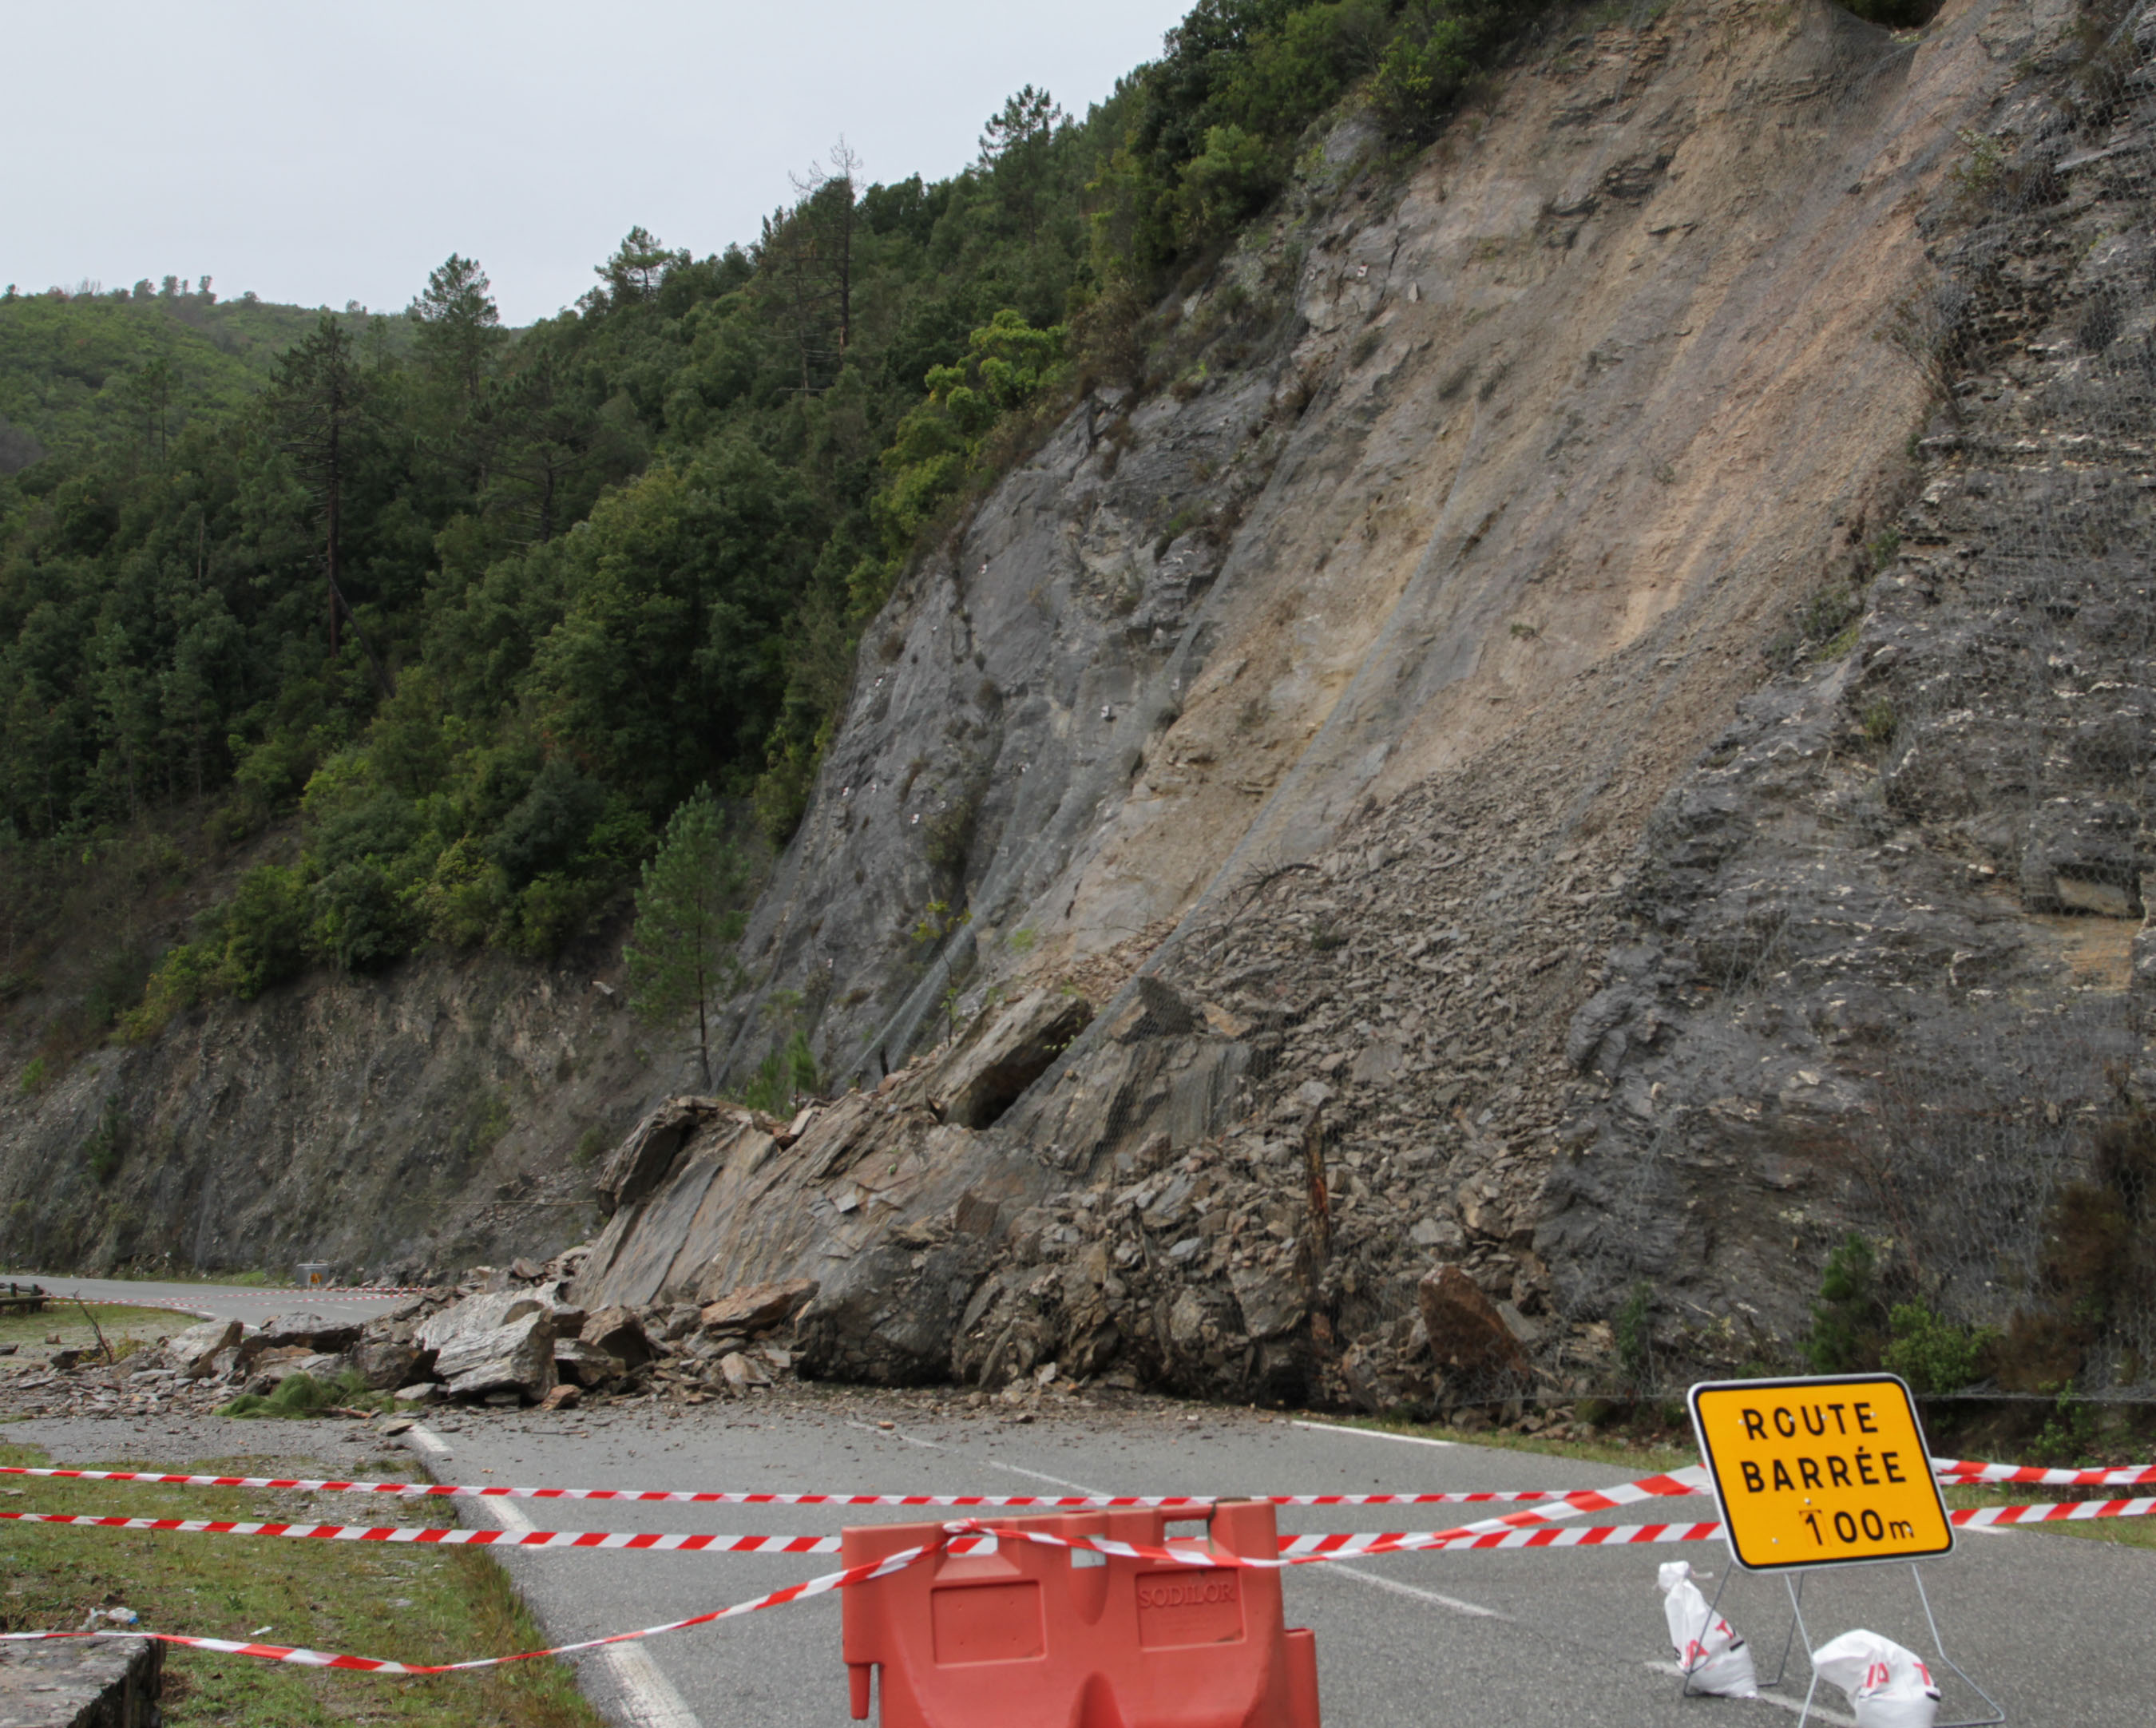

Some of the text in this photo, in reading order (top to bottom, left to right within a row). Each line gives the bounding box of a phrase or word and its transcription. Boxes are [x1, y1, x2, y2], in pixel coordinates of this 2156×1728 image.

[1742, 1402, 1878, 1440] ROUTE
[1740, 1446, 1907, 1493] BARRÉE
[1139, 1583, 1236, 1609] SODILOR
